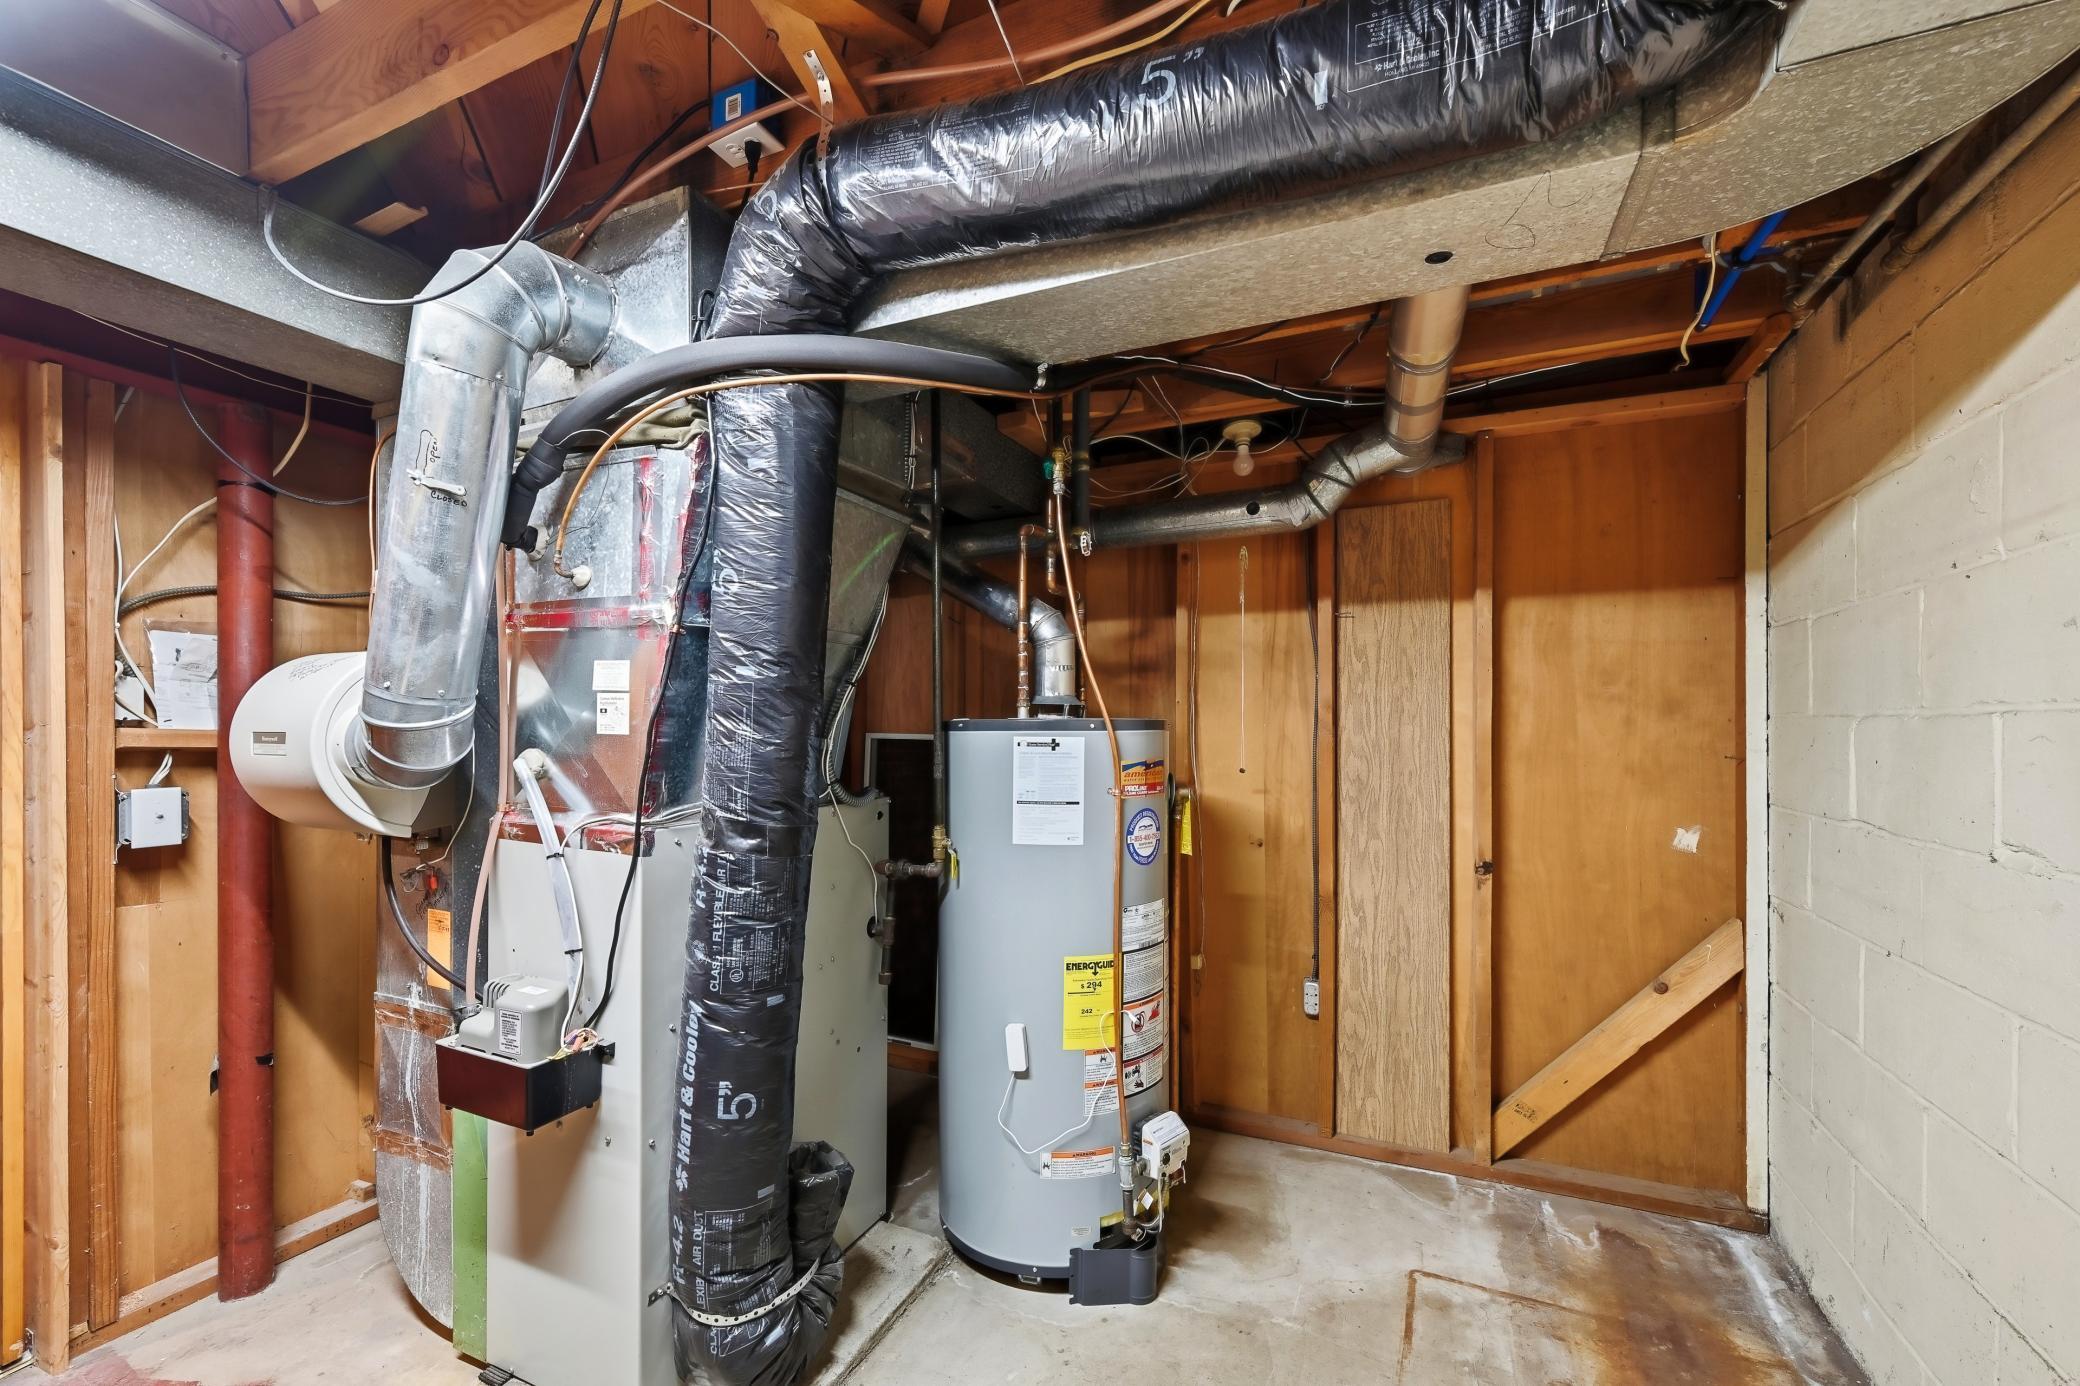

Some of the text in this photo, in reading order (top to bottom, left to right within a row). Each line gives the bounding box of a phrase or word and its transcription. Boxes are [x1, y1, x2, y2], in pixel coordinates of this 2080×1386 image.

[429, 438, 441, 463] OPEN
[430, 490, 468, 507] CLOSED
[1065, 960, 1115, 975] ENERGYGUID
[1081, 1008, 1093, 1016] 242
[676, 1000, 706, 1165] Hart & Cooley
[692, 1209, 705, 1242] DUCT
[671, 1205, 687, 1286] R-4.2
[692, 1245, 703, 1267] AIR
